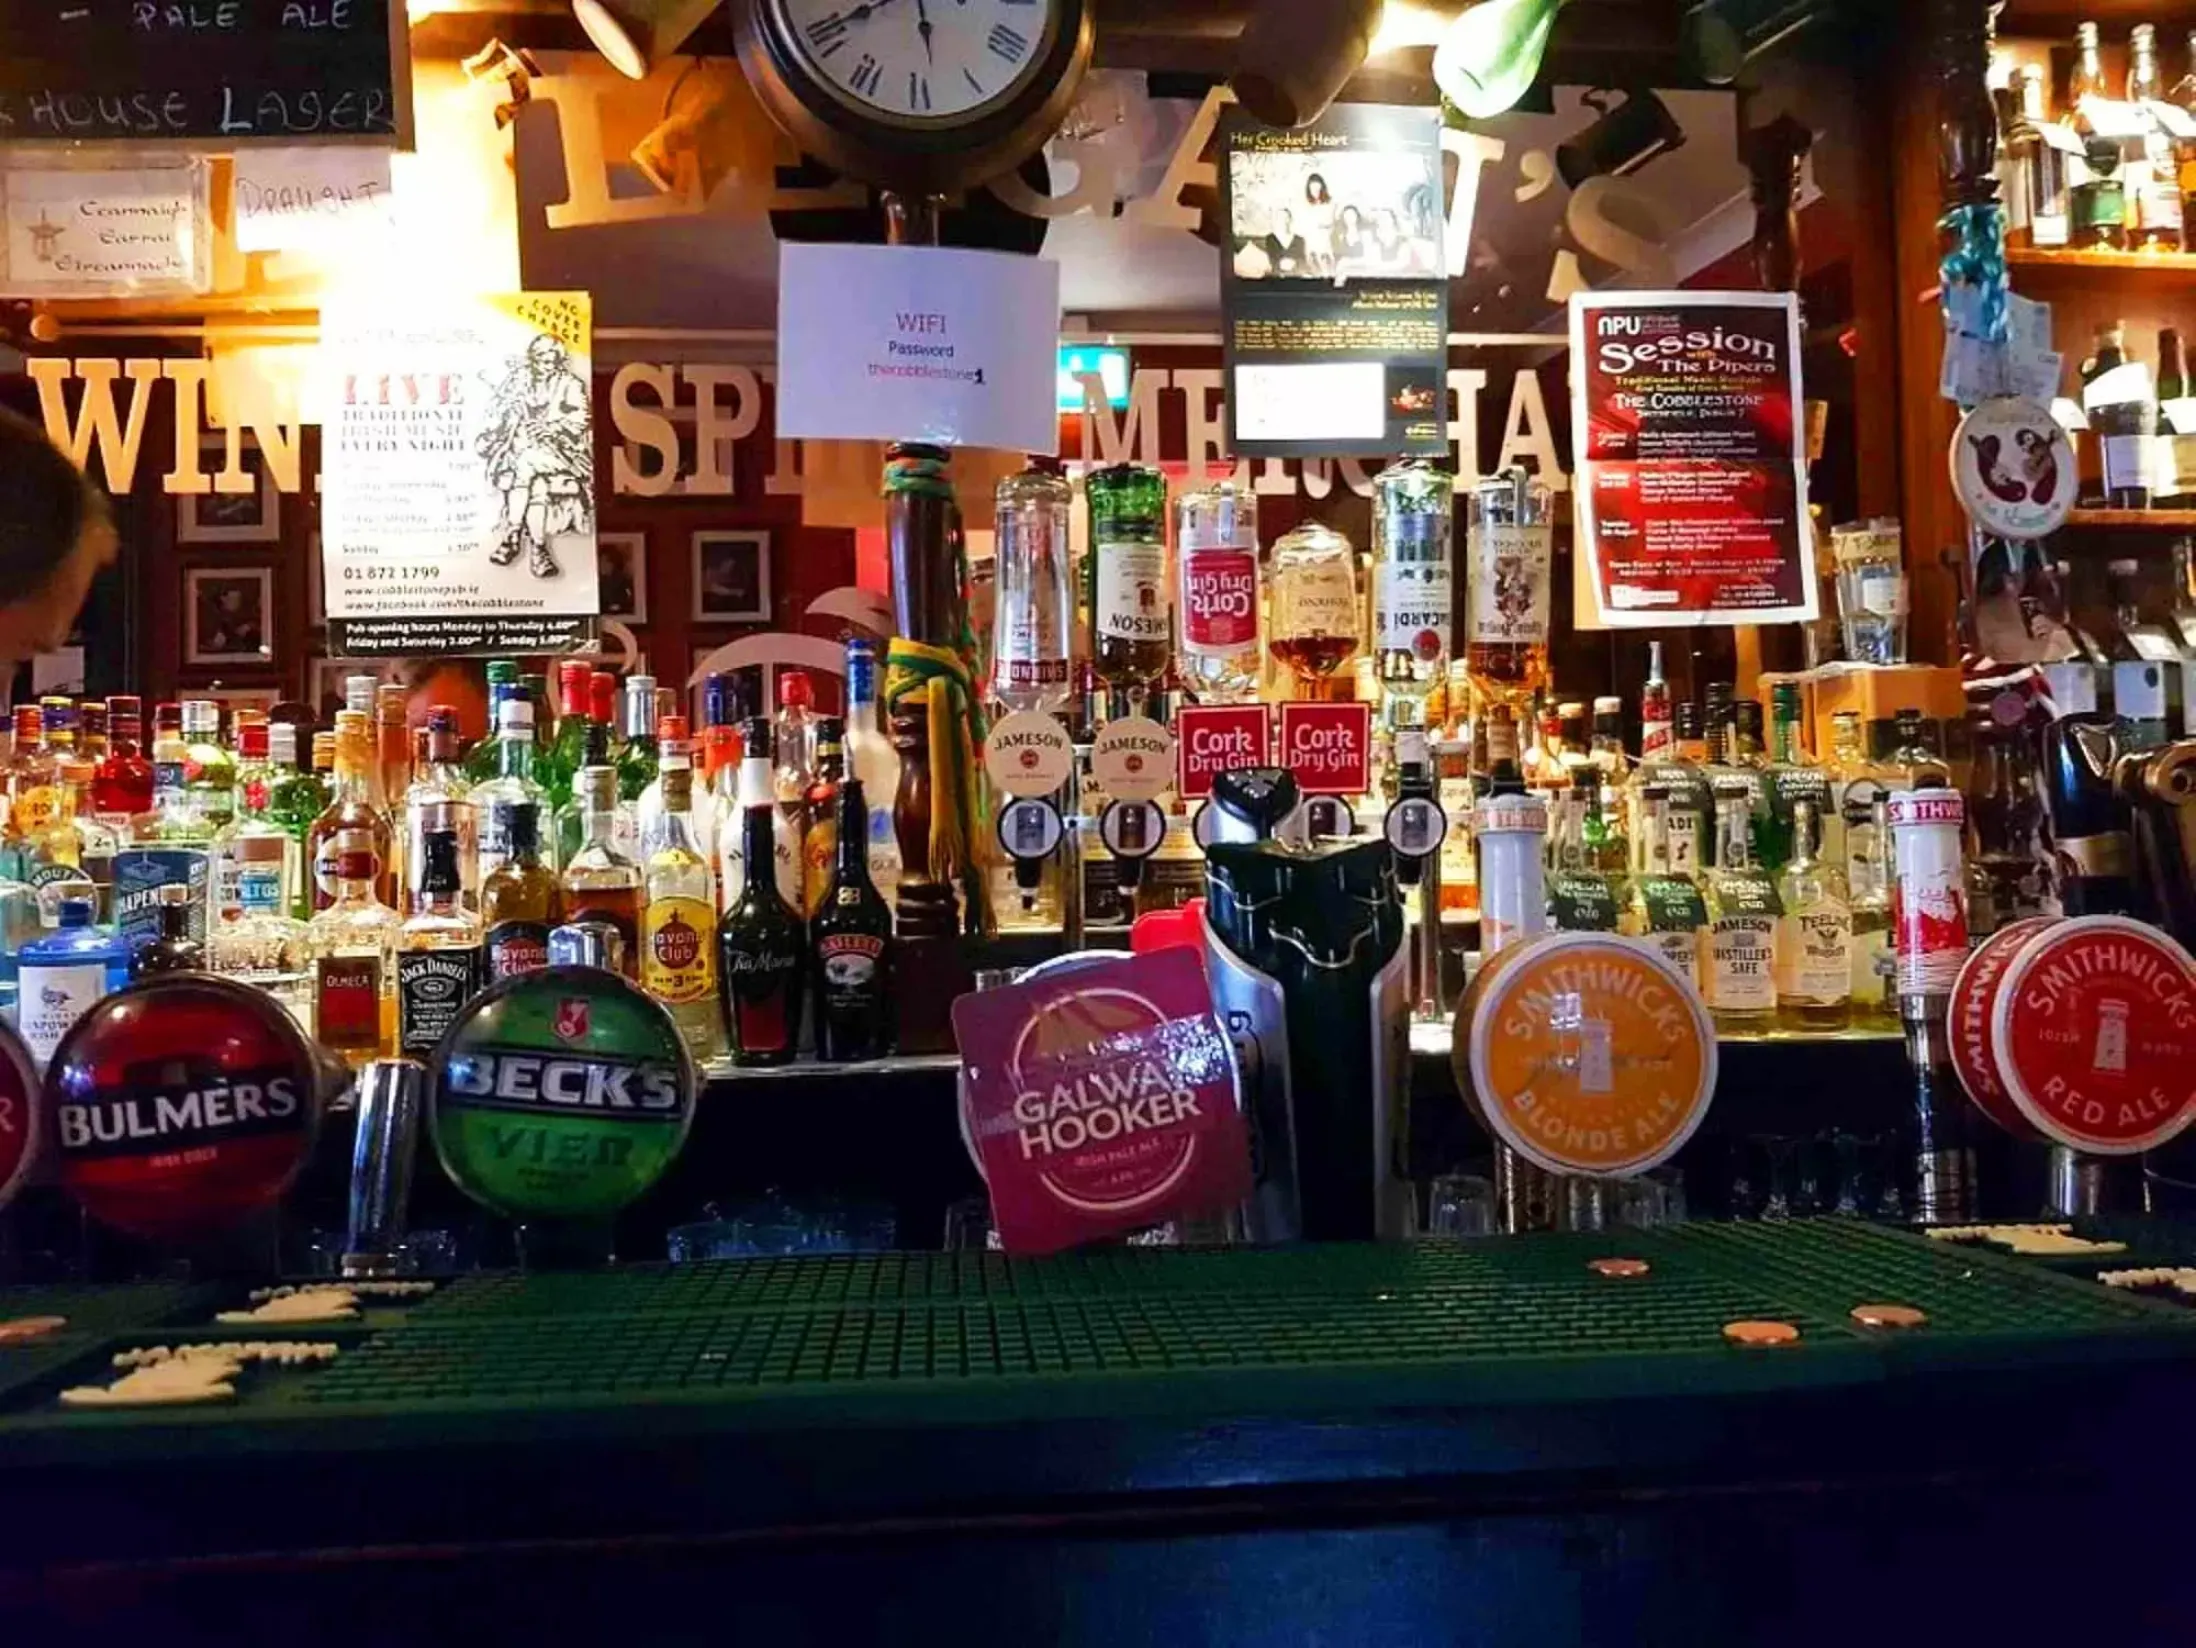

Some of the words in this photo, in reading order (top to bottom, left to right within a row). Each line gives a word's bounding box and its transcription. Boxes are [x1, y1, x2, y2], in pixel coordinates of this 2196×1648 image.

[31, 90, 189, 129] HOUSE
[1256, 132, 1309, 147] Crooked
[1311, 132, 1349, 146] Heart
[895, 313, 947, 334] WIFI
[888, 340, 954, 358] Password
[1599, 326, 1776, 373] Session
[1658, 359, 1702, 373] The
[1708, 359, 1776, 375] Pipers
[344, 374, 465, 405] LIVE
[27, 358, 322, 494] WIN
[343, 567, 363, 580] 01
[367, 567, 396, 580] 872
[401, 565, 441, 579] 1799
[411, 621, 441, 633] hours
[443, 622, 484, 634] Monday
[498, 620, 545, 633] Thursday
[401, 635, 448, 649] Saturday
[499, 634, 538, 647] Sunday
[994, 732, 1064, 751] JAMESON
[1100, 736, 1168, 756] JAMESON
[1192, 726, 1255, 755] Cork
[1294, 723, 1356, 751] Cork
[1187, 754, 1224, 773] Dry
[1226, 752, 1260, 771] Gin
[1290, 749, 1325, 773] Dry
[1326, 748, 1361, 773] Gin
[1713, 918, 1773, 934] JAMESON
[658, 946, 693, 962] Club
[400, 960, 428, 982] JACK
[1730, 961, 1758, 975] SAFE
[325, 973, 371, 989] OLMECA
[1013, 1060, 1187, 1125] GALWA
[2042, 1074, 2105, 1125] RED
[2117, 1087, 2171, 1127] ALE
[58, 1077, 297, 1148] BULMERS
[1513, 1090, 1630, 1152] BLONDE
[1636, 1091, 1680, 1141] ALE
[1019, 1090, 1202, 1160] HOOKER
[486, 1124, 635, 1167] VIER
